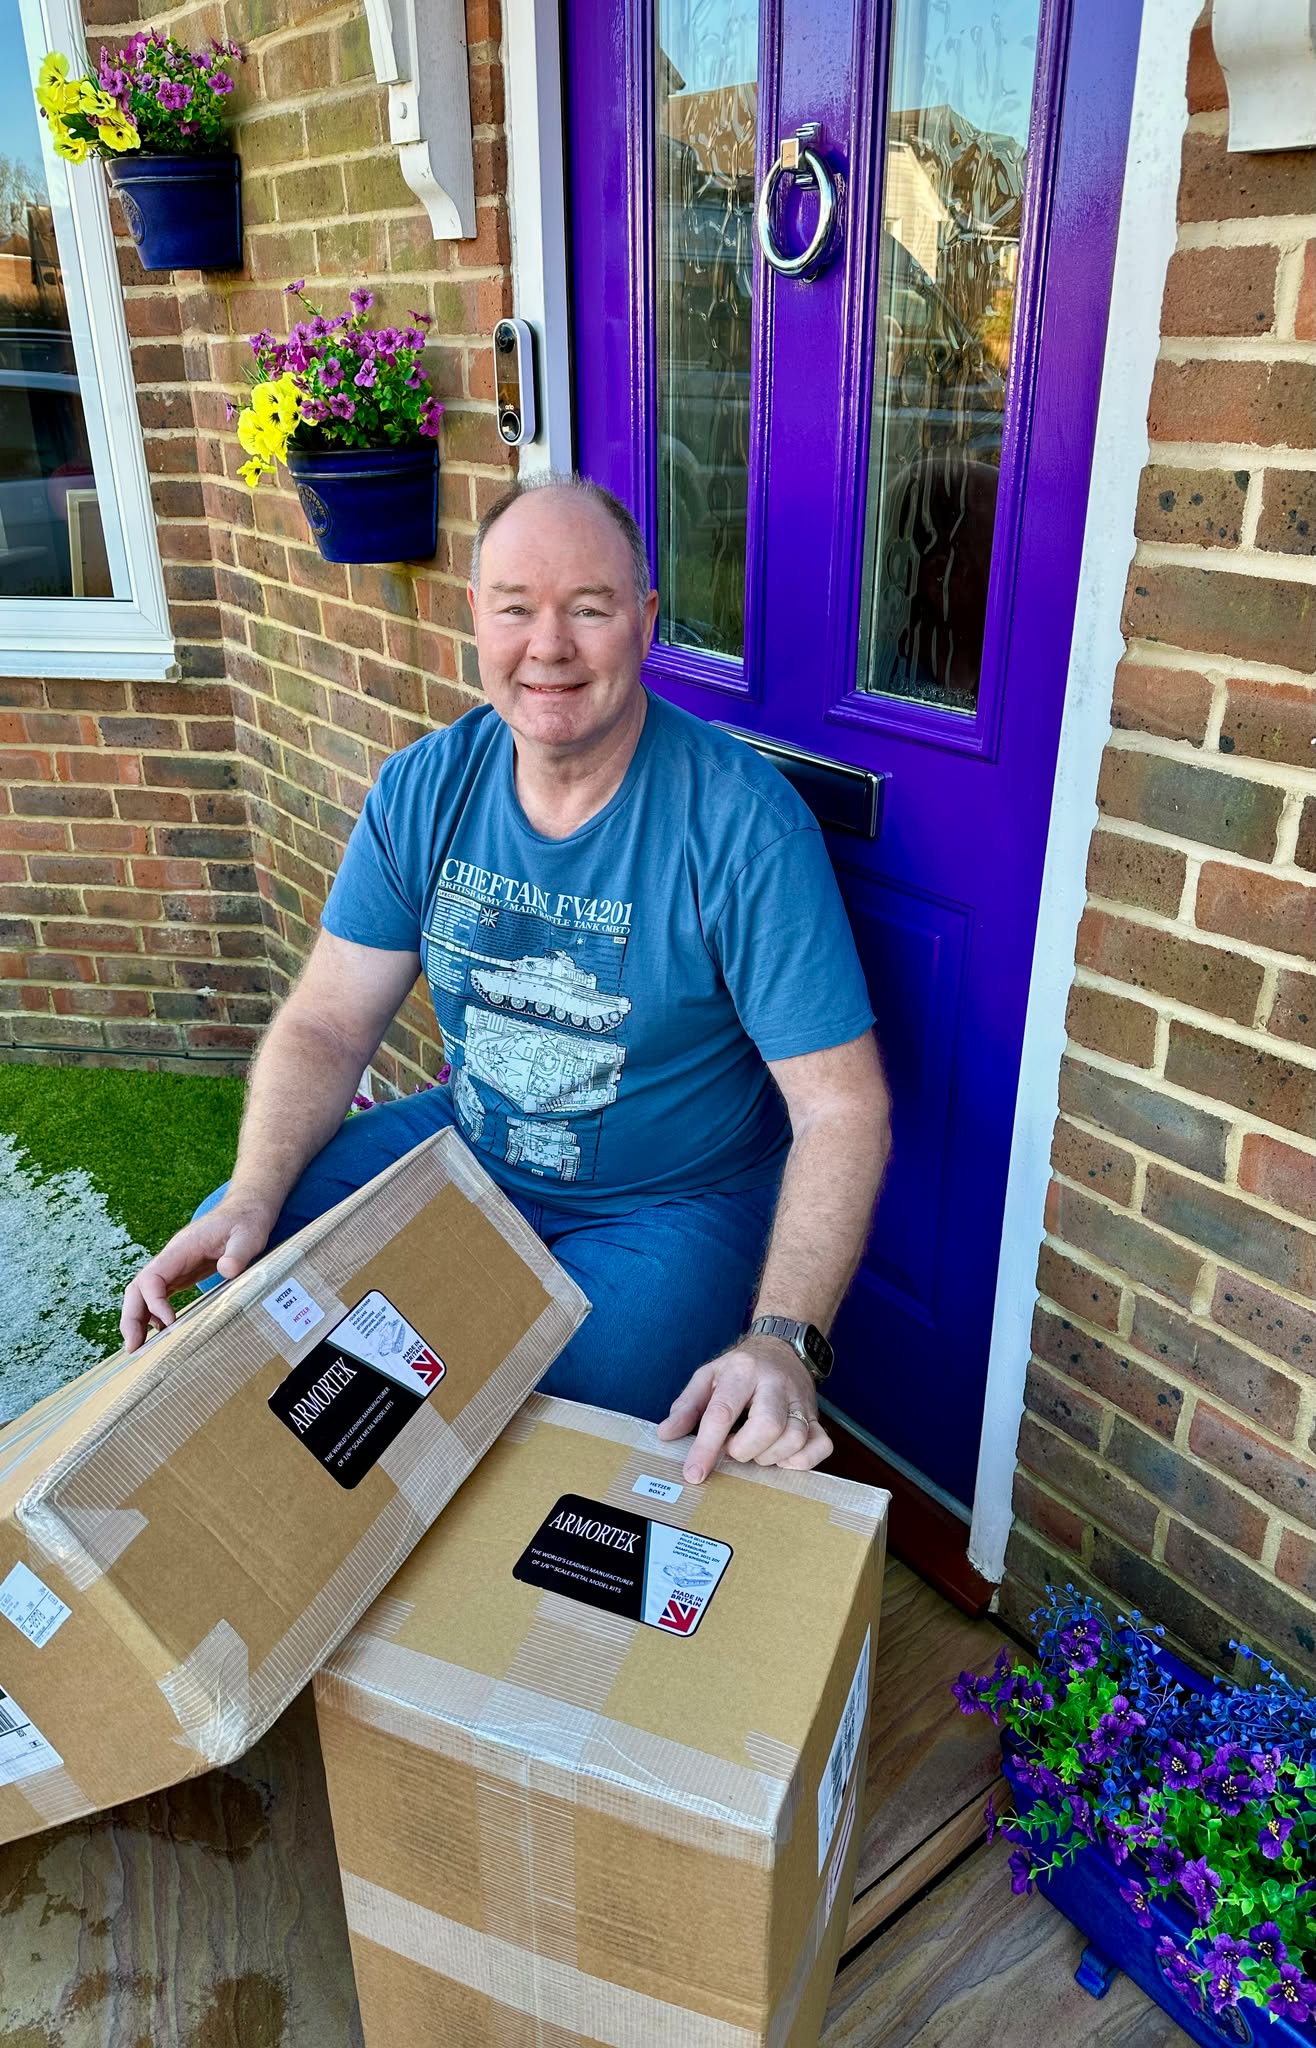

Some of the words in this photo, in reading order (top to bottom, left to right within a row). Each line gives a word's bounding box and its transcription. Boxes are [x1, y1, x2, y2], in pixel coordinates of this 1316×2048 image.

[439, 879, 475, 897] BRITISH
[477, 893, 503, 906] ARMY
[510, 902, 538, 915] MAIN
[574, 920, 600, 931] TANK
[602, 925, 630, 934] (MBT)
[554, 894, 632, 925] FV4201
[275, 1287, 292, 1303] HETZER
[283, 1299, 294, 1309] BOX
[293, 1306, 310, 1323] HETZER
[402, 1344, 415, 1360] MADE
[414, 1339, 420, 1347] IN
[406, 1343, 424, 1364] BRITAIN
[288, 1356, 358, 1434] ARMORTEK
[324, 1451, 335, 1462] THE
[332, 1433, 350, 1454] WORLD'S
[347, 1417, 365, 1436] LEADING
[361, 1386, 390, 1420] MANUFACTURER
[337, 1458, 344, 1467] OF
[351, 1435, 365, 1450] SCALE
[361, 1423, 375, 1437] METAL
[372, 1408, 387, 1425] MODEL
[384, 1400, 394, 1411] KITS
[649, 1482, 671, 1490] HETZER
[548, 1510, 641, 1554] ARMORTEK
[542, 1552, 567, 1564] WORLD'S
[566, 1560, 589, 1571] LEADING
[589, 1567, 634, 1586] MANUFACTURER
[554, 1566, 572, 1576] SCALE
[570, 1571, 589, 1582] METAL
[588, 1578, 609, 1589] MODEL
[609, 1585, 622, 1593] KITS
[670, 1594, 702, 1607] BRITAIN
[673, 1589, 695, 1600] MADE
